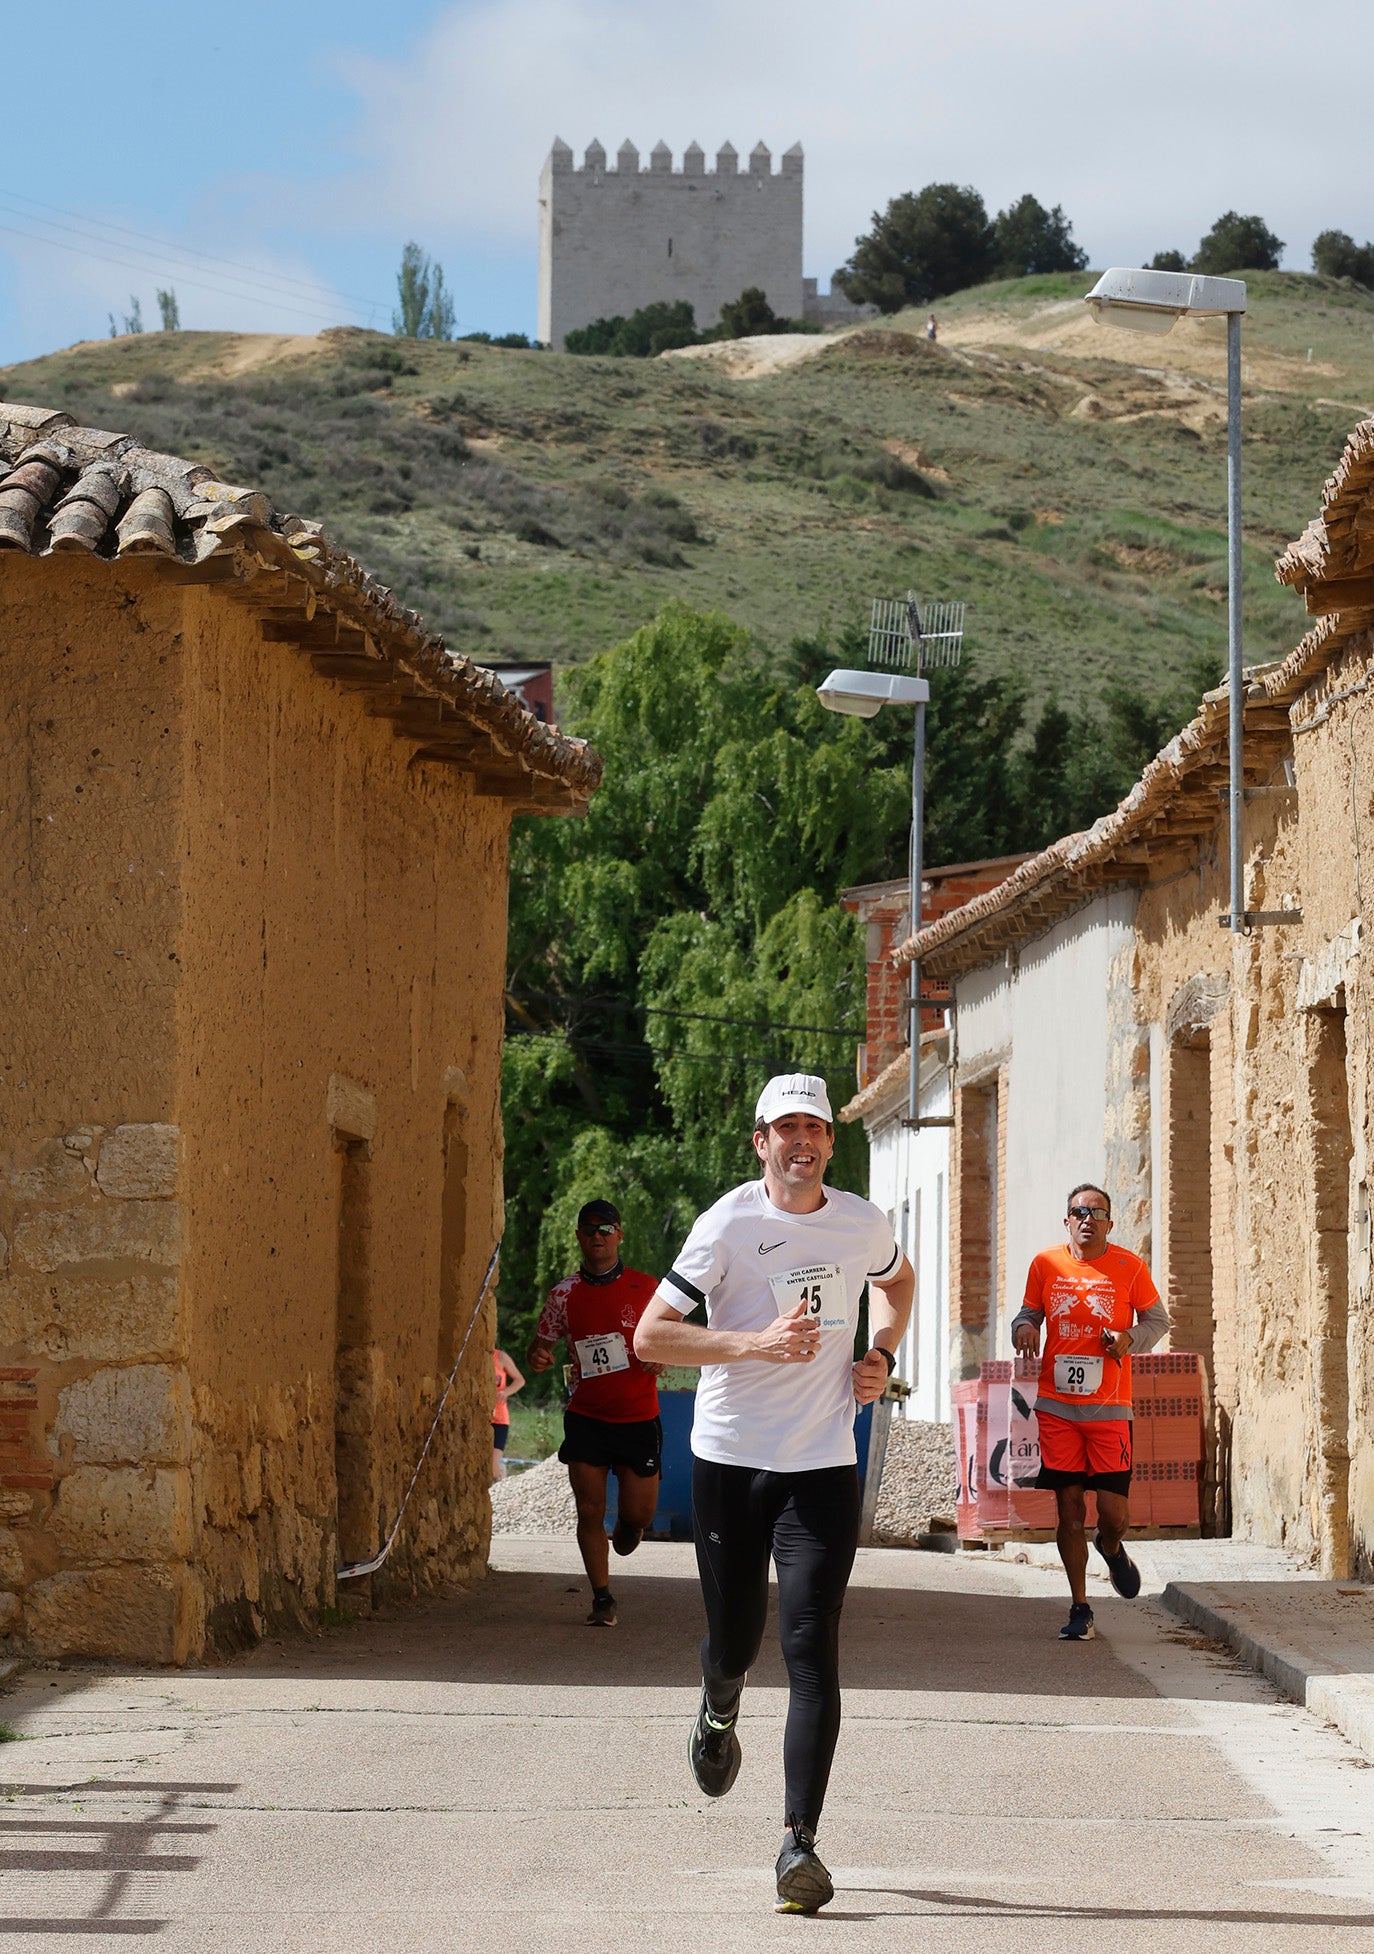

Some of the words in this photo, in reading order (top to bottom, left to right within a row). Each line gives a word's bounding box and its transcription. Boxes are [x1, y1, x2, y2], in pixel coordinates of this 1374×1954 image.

[782, 1090, 816, 1098] HEAD
[801, 1266, 827, 1275] CARRERA
[807, 1274, 833, 1282] CASTILLOS
[800, 1285, 822, 1316] 15
[593, 1348, 609, 1365] 43
[1067, 1366, 1085, 1385] 29
